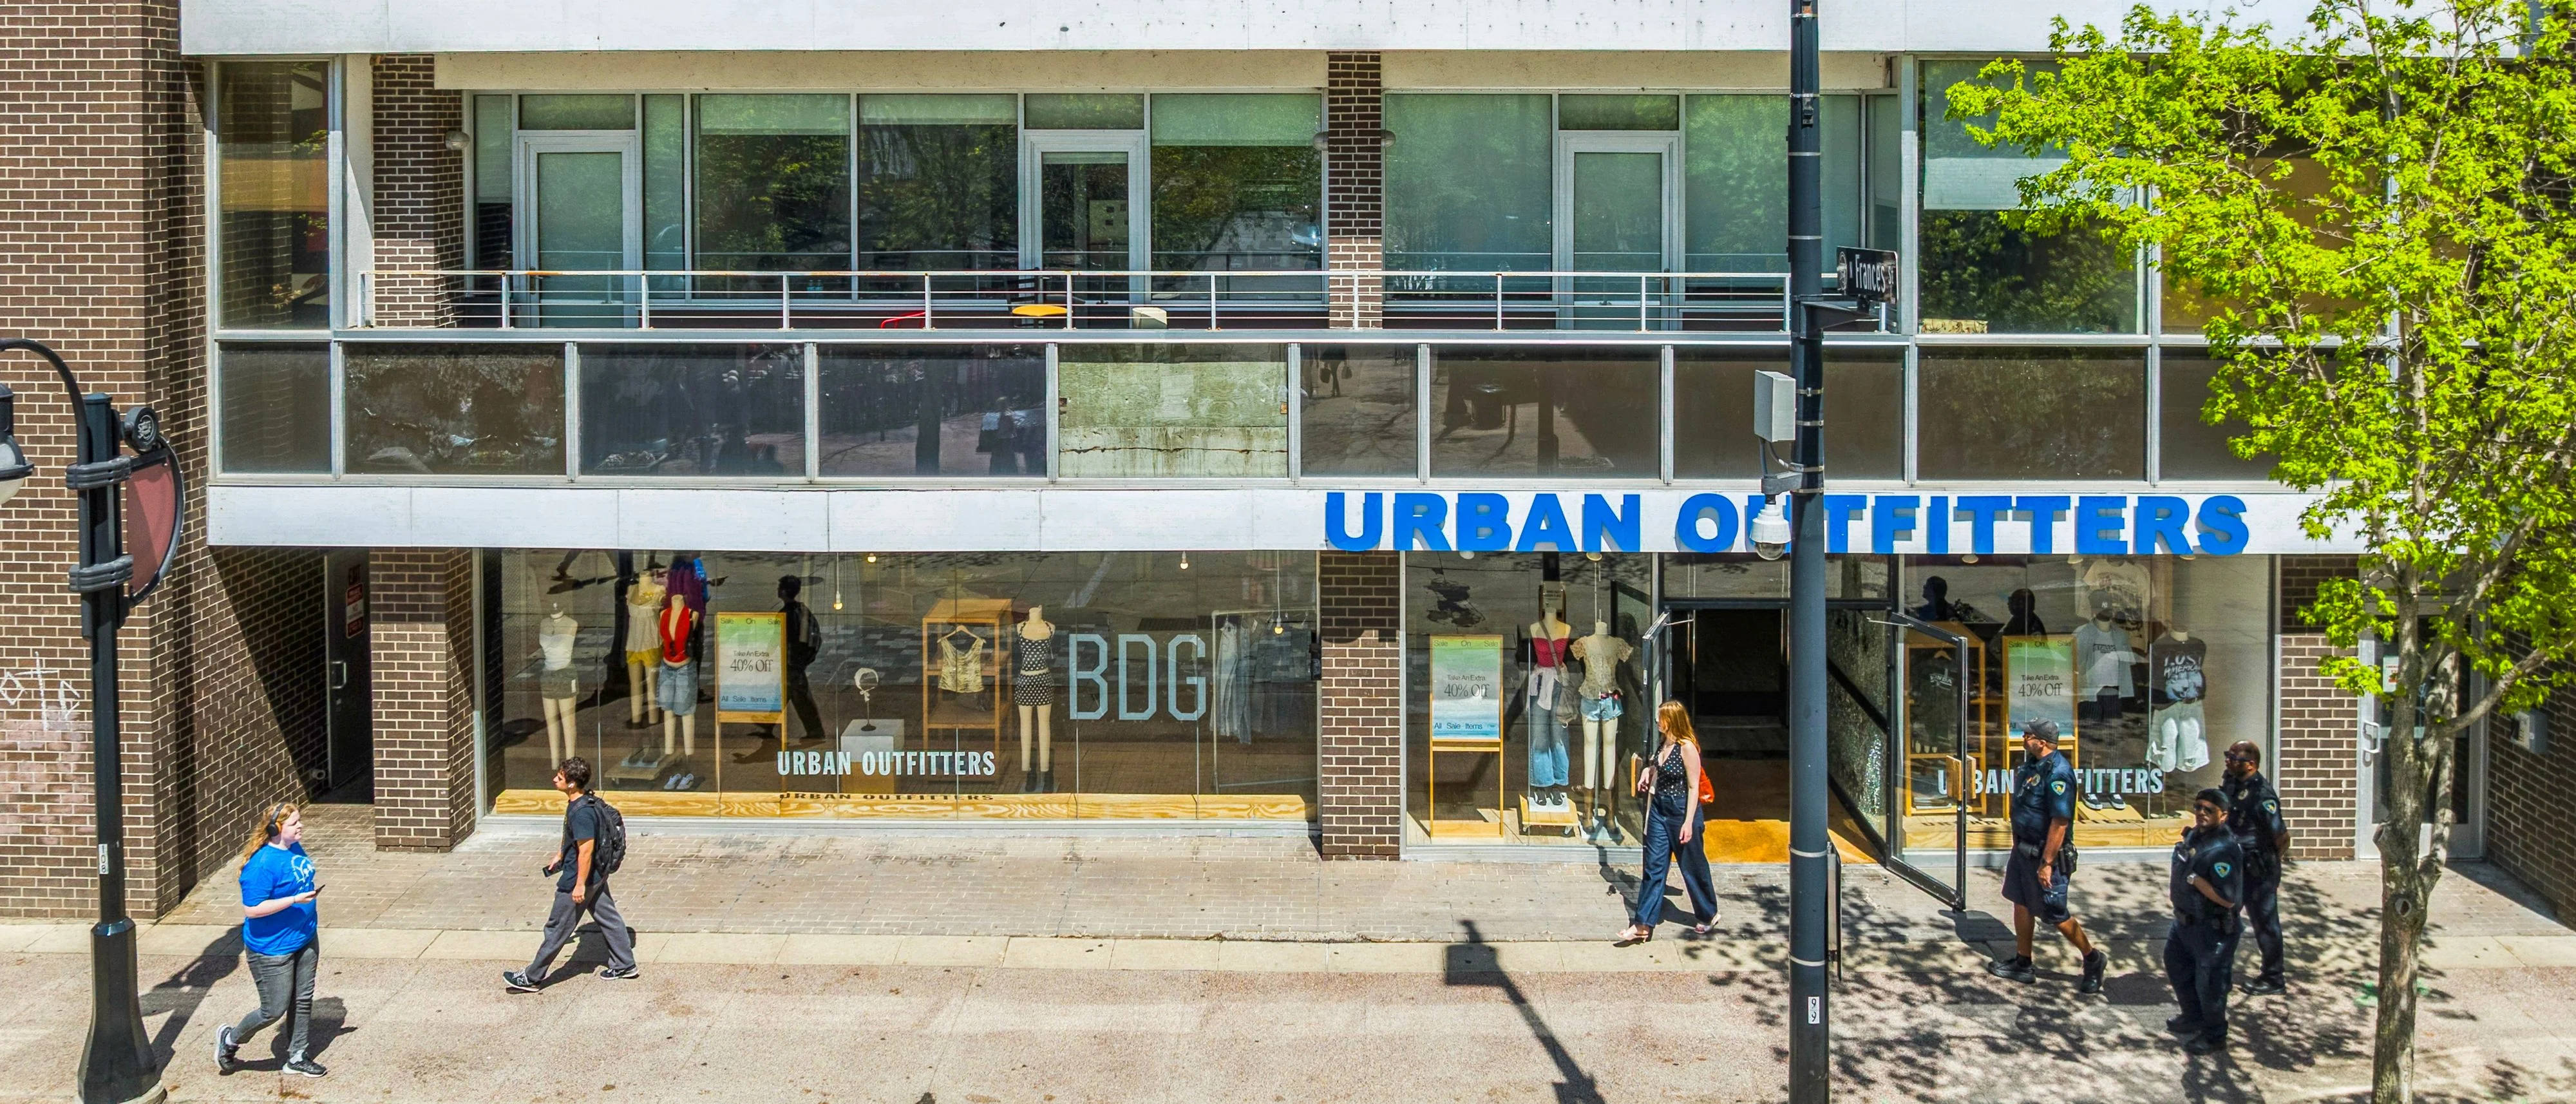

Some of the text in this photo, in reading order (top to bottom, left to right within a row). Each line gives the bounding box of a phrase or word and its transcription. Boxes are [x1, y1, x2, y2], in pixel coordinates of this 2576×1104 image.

[1855, 254, 1886, 293] Frances
[1325, 491, 2249, 554] URBAN OTFITTERS
[730, 659, 773, 672] 40% Off
[1069, 633, 1206, 721] BDG
[1444, 683, 1490, 697] 40% Off
[2018, 683, 2063, 697] 40% Off
[777, 751, 996, 776] URBAN OUTFITTERS
[1937, 768, 2014, 795] UBAN
[2073, 768, 2163, 794] FITTERS
